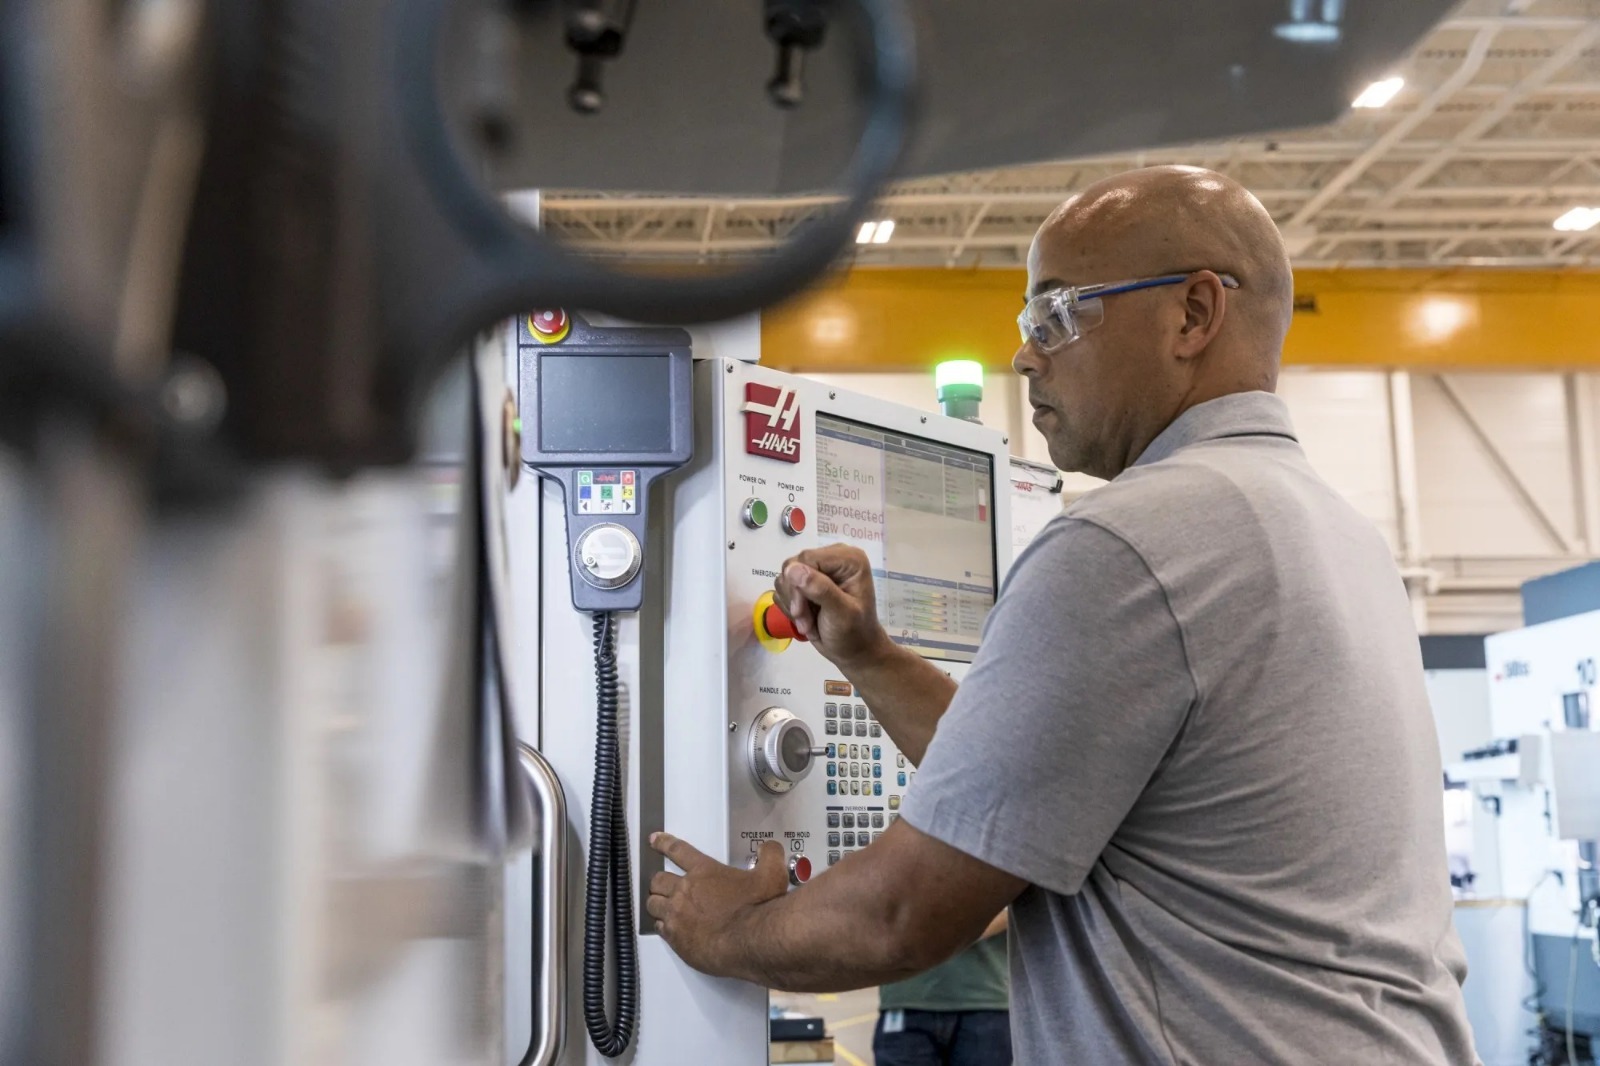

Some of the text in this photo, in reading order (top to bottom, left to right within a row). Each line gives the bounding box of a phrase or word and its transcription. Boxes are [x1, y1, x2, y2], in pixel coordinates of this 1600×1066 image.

[751, 431, 801, 455] HAAS
[739, 474, 757, 484] POWER
[824, 462, 874, 485] Safe Run
[777, 482, 795, 490] POWER
[836, 485, 860, 501] Tool
[817, 501, 885, 524] Unprotected
[817, 520, 885, 542] Low Coolant
[760, 687, 779, 695] HANDLE
[741, 831, 758, 839] CYCLE
